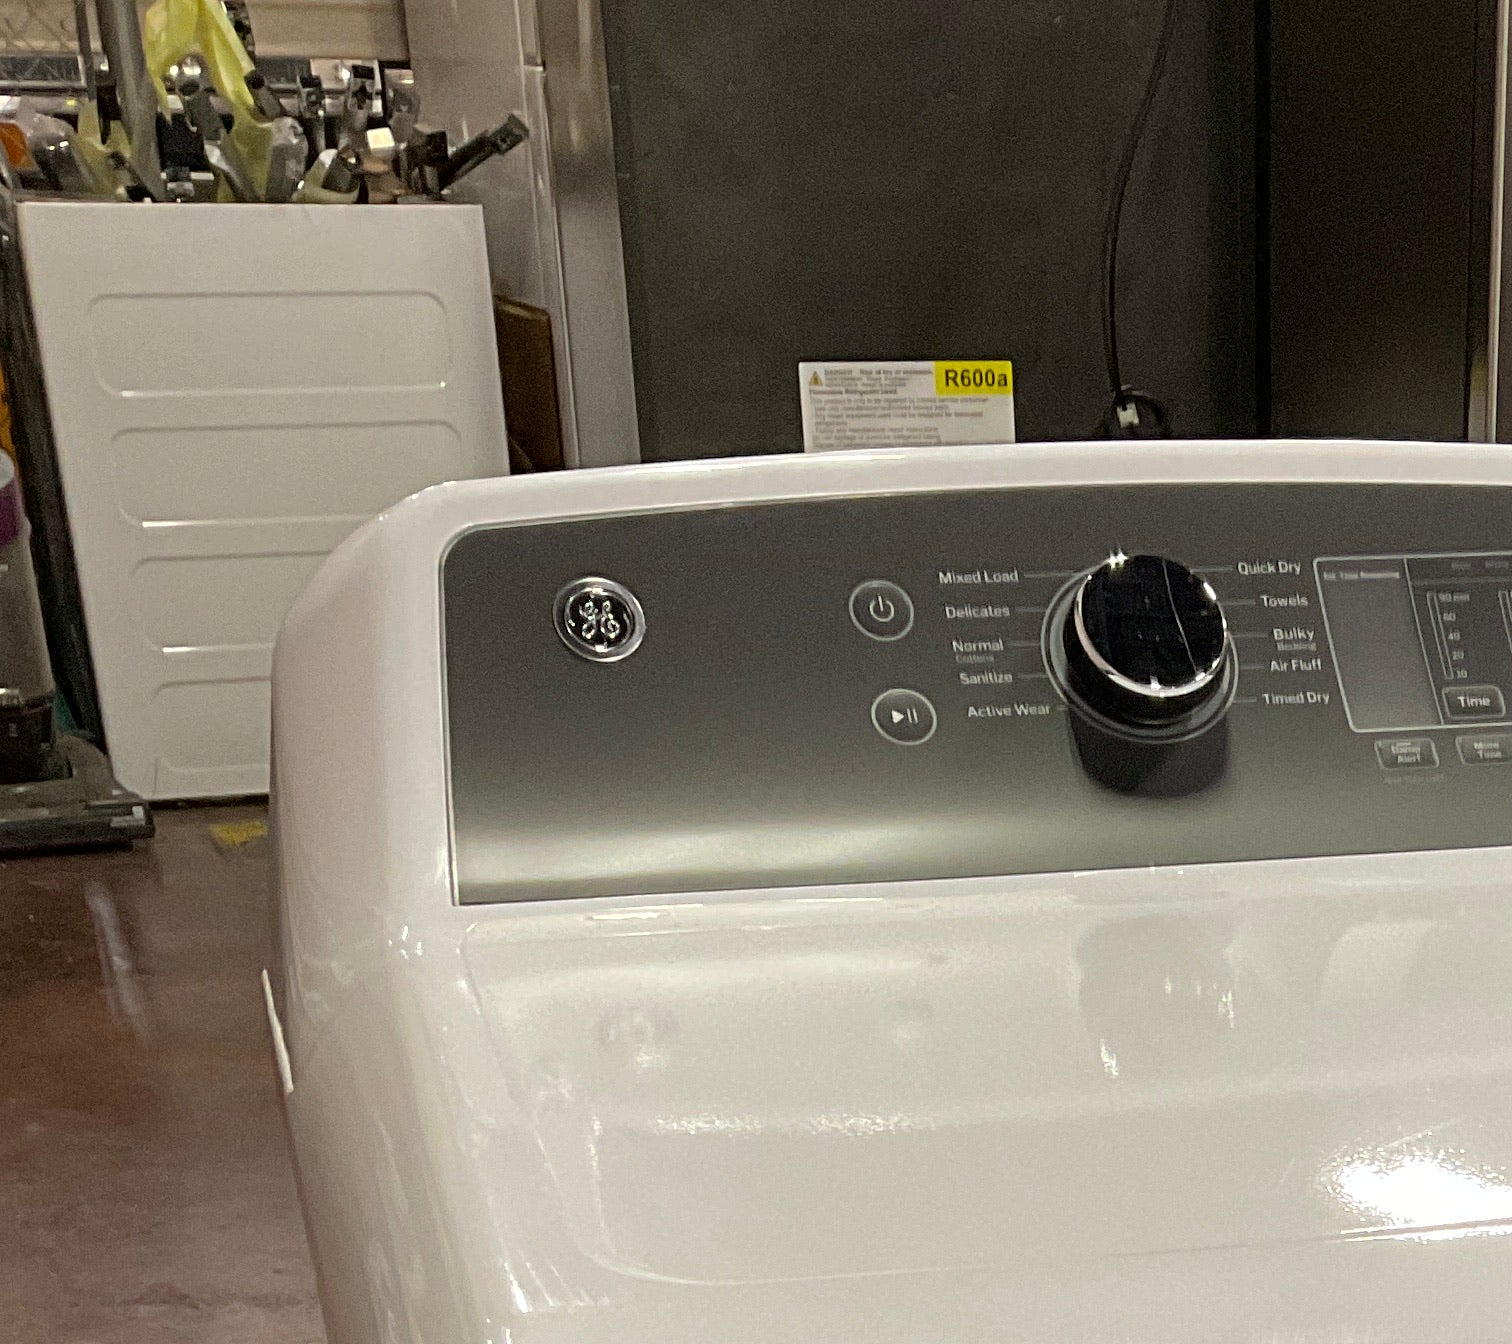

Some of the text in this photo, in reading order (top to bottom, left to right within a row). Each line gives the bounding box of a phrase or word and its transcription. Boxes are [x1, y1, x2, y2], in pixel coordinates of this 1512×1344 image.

[945, 369, 1008, 388] R600a
[1238, 561, 1301, 575] Quick Dry
[939, 568, 1019, 584] Mixed Load
[1260, 594, 1308, 607] Towels
[1439, 591, 1451, 601] 90
[945, 603, 1010, 619] Delicates
[1273, 627, 1315, 641] Bulky
[1448, 631, 1460, 641] 40
[952, 639, 1004, 652] Normal
[1271, 659, 1322, 672] Air Fluff
[960, 670, 1013, 685] Sanitize
[1262, 691, 1330, 706] Timed Dry
[1457, 696, 1490, 708] Time
[968, 703, 1050, 718] Active Wear
